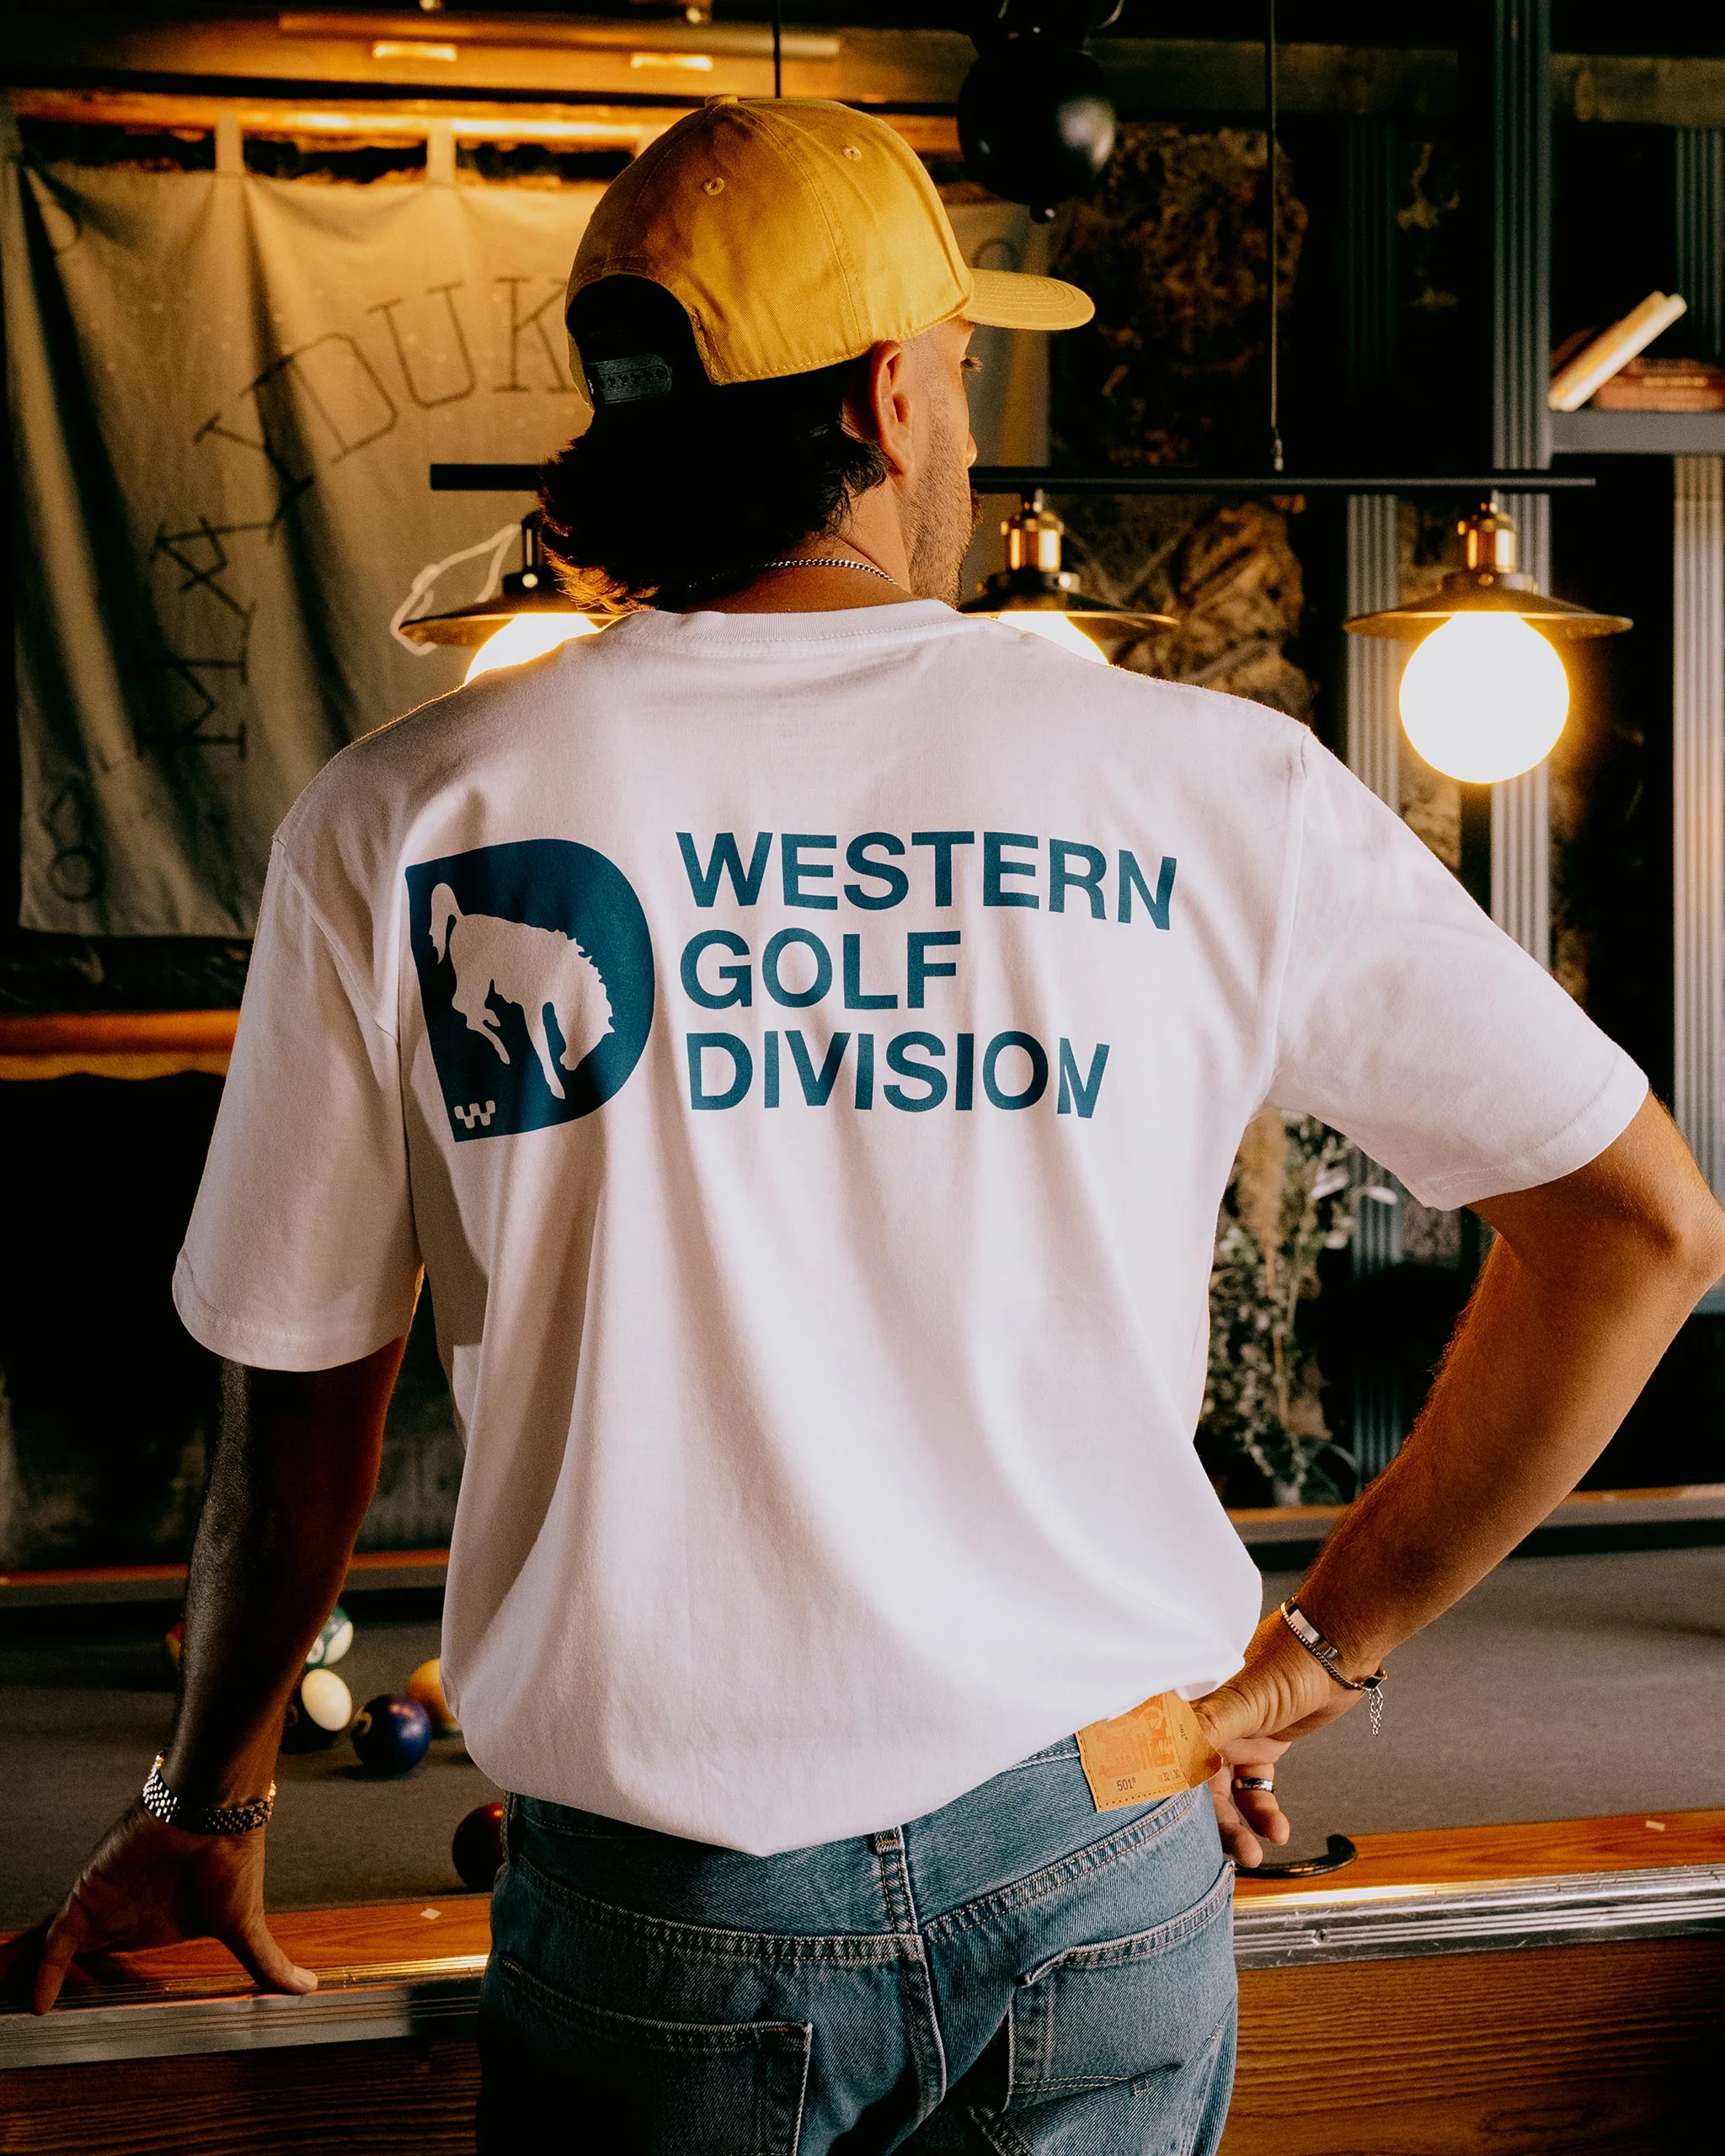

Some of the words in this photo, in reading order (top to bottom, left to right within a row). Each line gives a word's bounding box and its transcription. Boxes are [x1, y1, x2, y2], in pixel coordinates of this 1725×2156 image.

[676, 830, 1177, 931] WESTERN
[679, 927, 961, 1010] GOLF
[686, 1029, 1110, 1118] DIVISION
